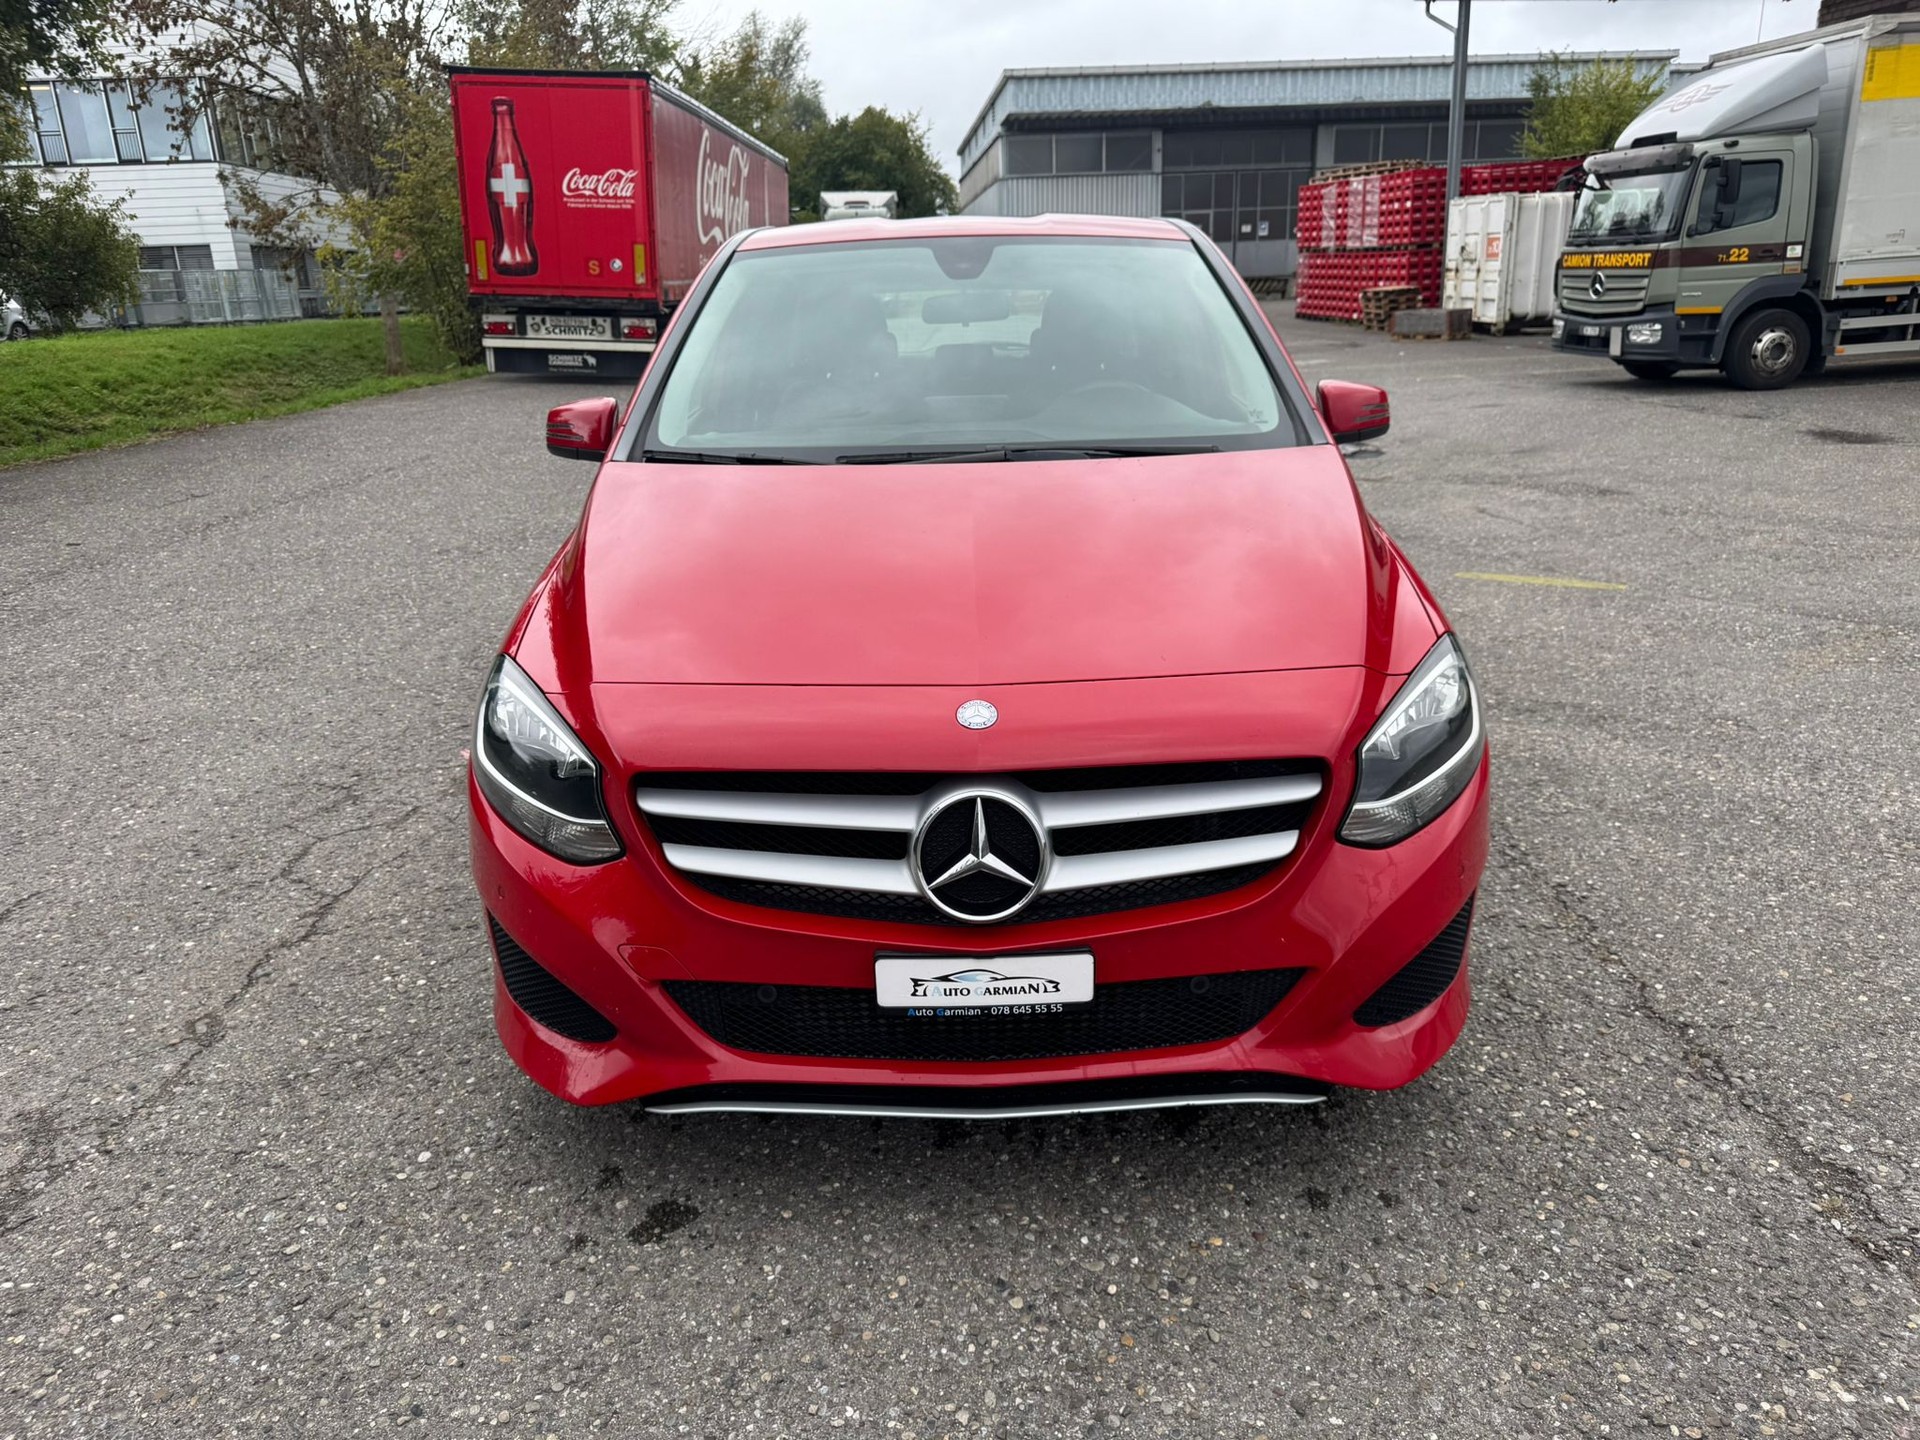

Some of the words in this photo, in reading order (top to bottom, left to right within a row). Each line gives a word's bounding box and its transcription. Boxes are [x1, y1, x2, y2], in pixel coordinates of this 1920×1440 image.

[562, 167, 639, 197] Coca-Cola
[1562, 253, 1592, 268] CAMION
[1593, 252, 1652, 267] TRANSPORT
[544, 326, 597, 336] SCHMITZ
[907, 1007, 934, 1016] Auto
[936, 1007, 981, 1016] Garmian
[991, 1006, 1010, 1015] 078
[1013, 1005, 1032, 1014] 645
[1035, 1004, 1047, 1013] 55
[1050, 1003, 1063, 1013] 55
